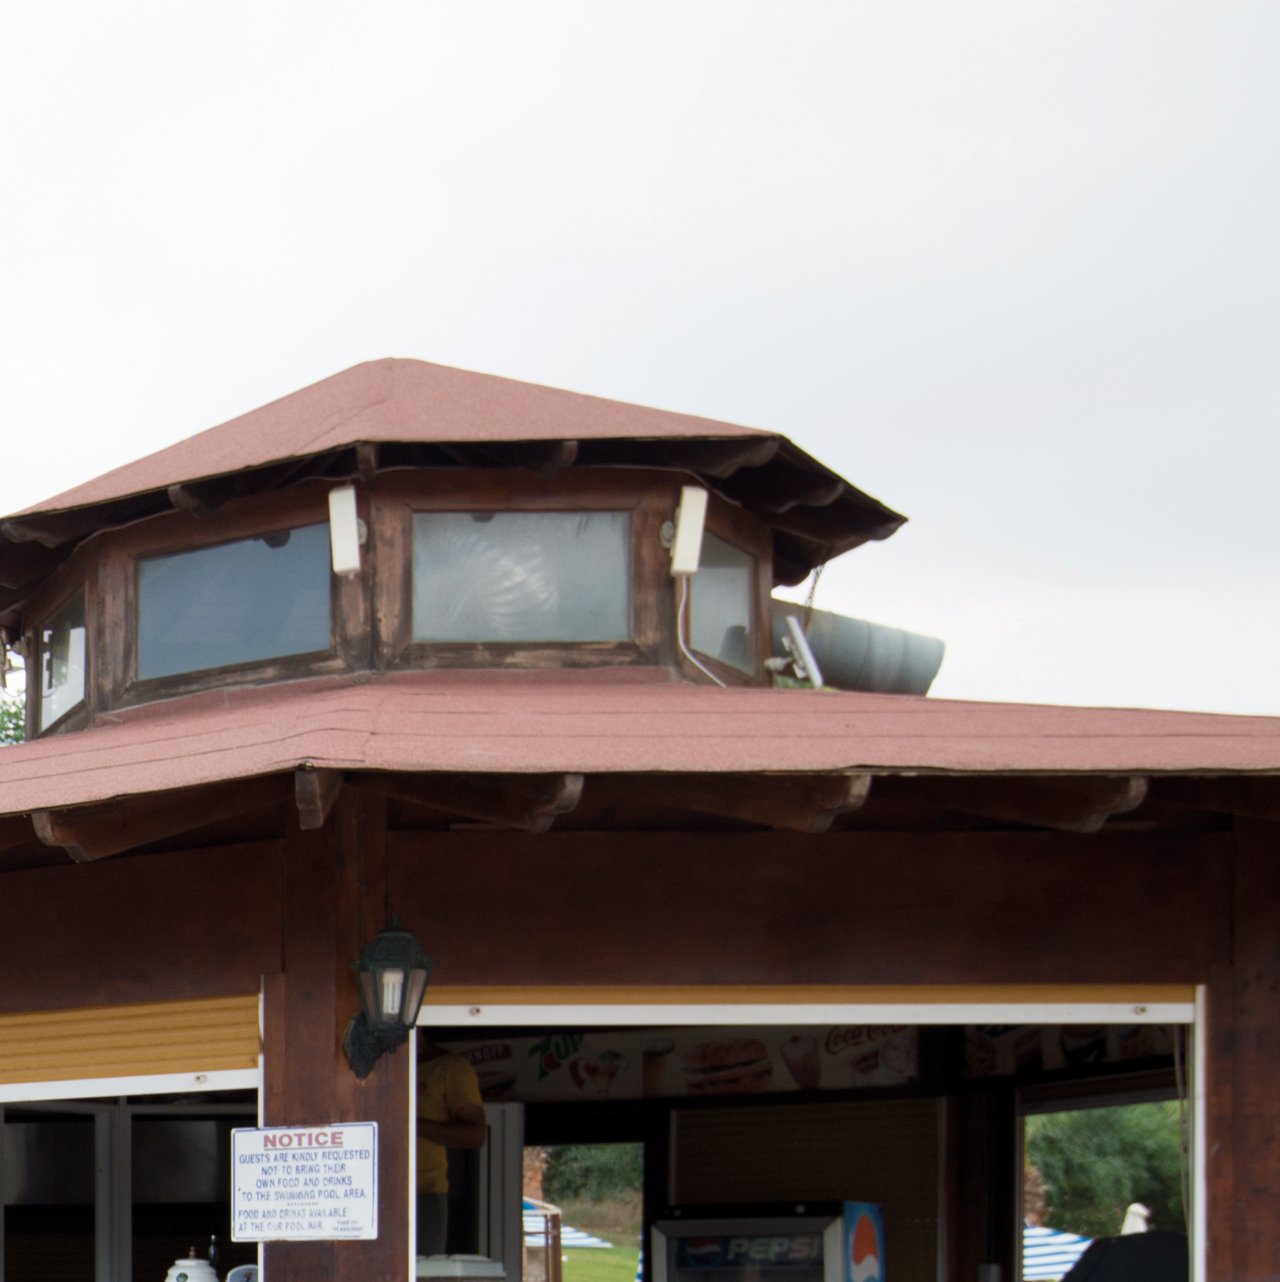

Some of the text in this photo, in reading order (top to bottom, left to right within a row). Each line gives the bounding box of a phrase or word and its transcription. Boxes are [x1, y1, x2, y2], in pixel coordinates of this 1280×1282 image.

[263, 1131, 344, 1148] NOTICE
[239, 1150, 370, 1164] GUESTS ARE KINDLY REQUESTED
[261, 1163, 346, 1176] NOT TO BRING THEIR
[256, 1176, 353, 1189] OWN FOOD AND DRINKS
[241, 1192, 252, 1202] TO
[256, 1191, 270, 1201] THE
[274, 1190, 316, 1200] SWIMMING
[318, 1189, 340, 1199] POOL
[238, 1207, 347, 1219] FOOD AND DRINKS AVAILABLE
[238, 1222, 248, 1232] AT
[251, 1222, 263, 1232] THE
[267, 1221, 282, 1231] OUR
[285, 1221, 305, 1231] POOL
[308, 1220, 323, 1230] BAR
[727, 1236, 820, 1262] PEPSI
